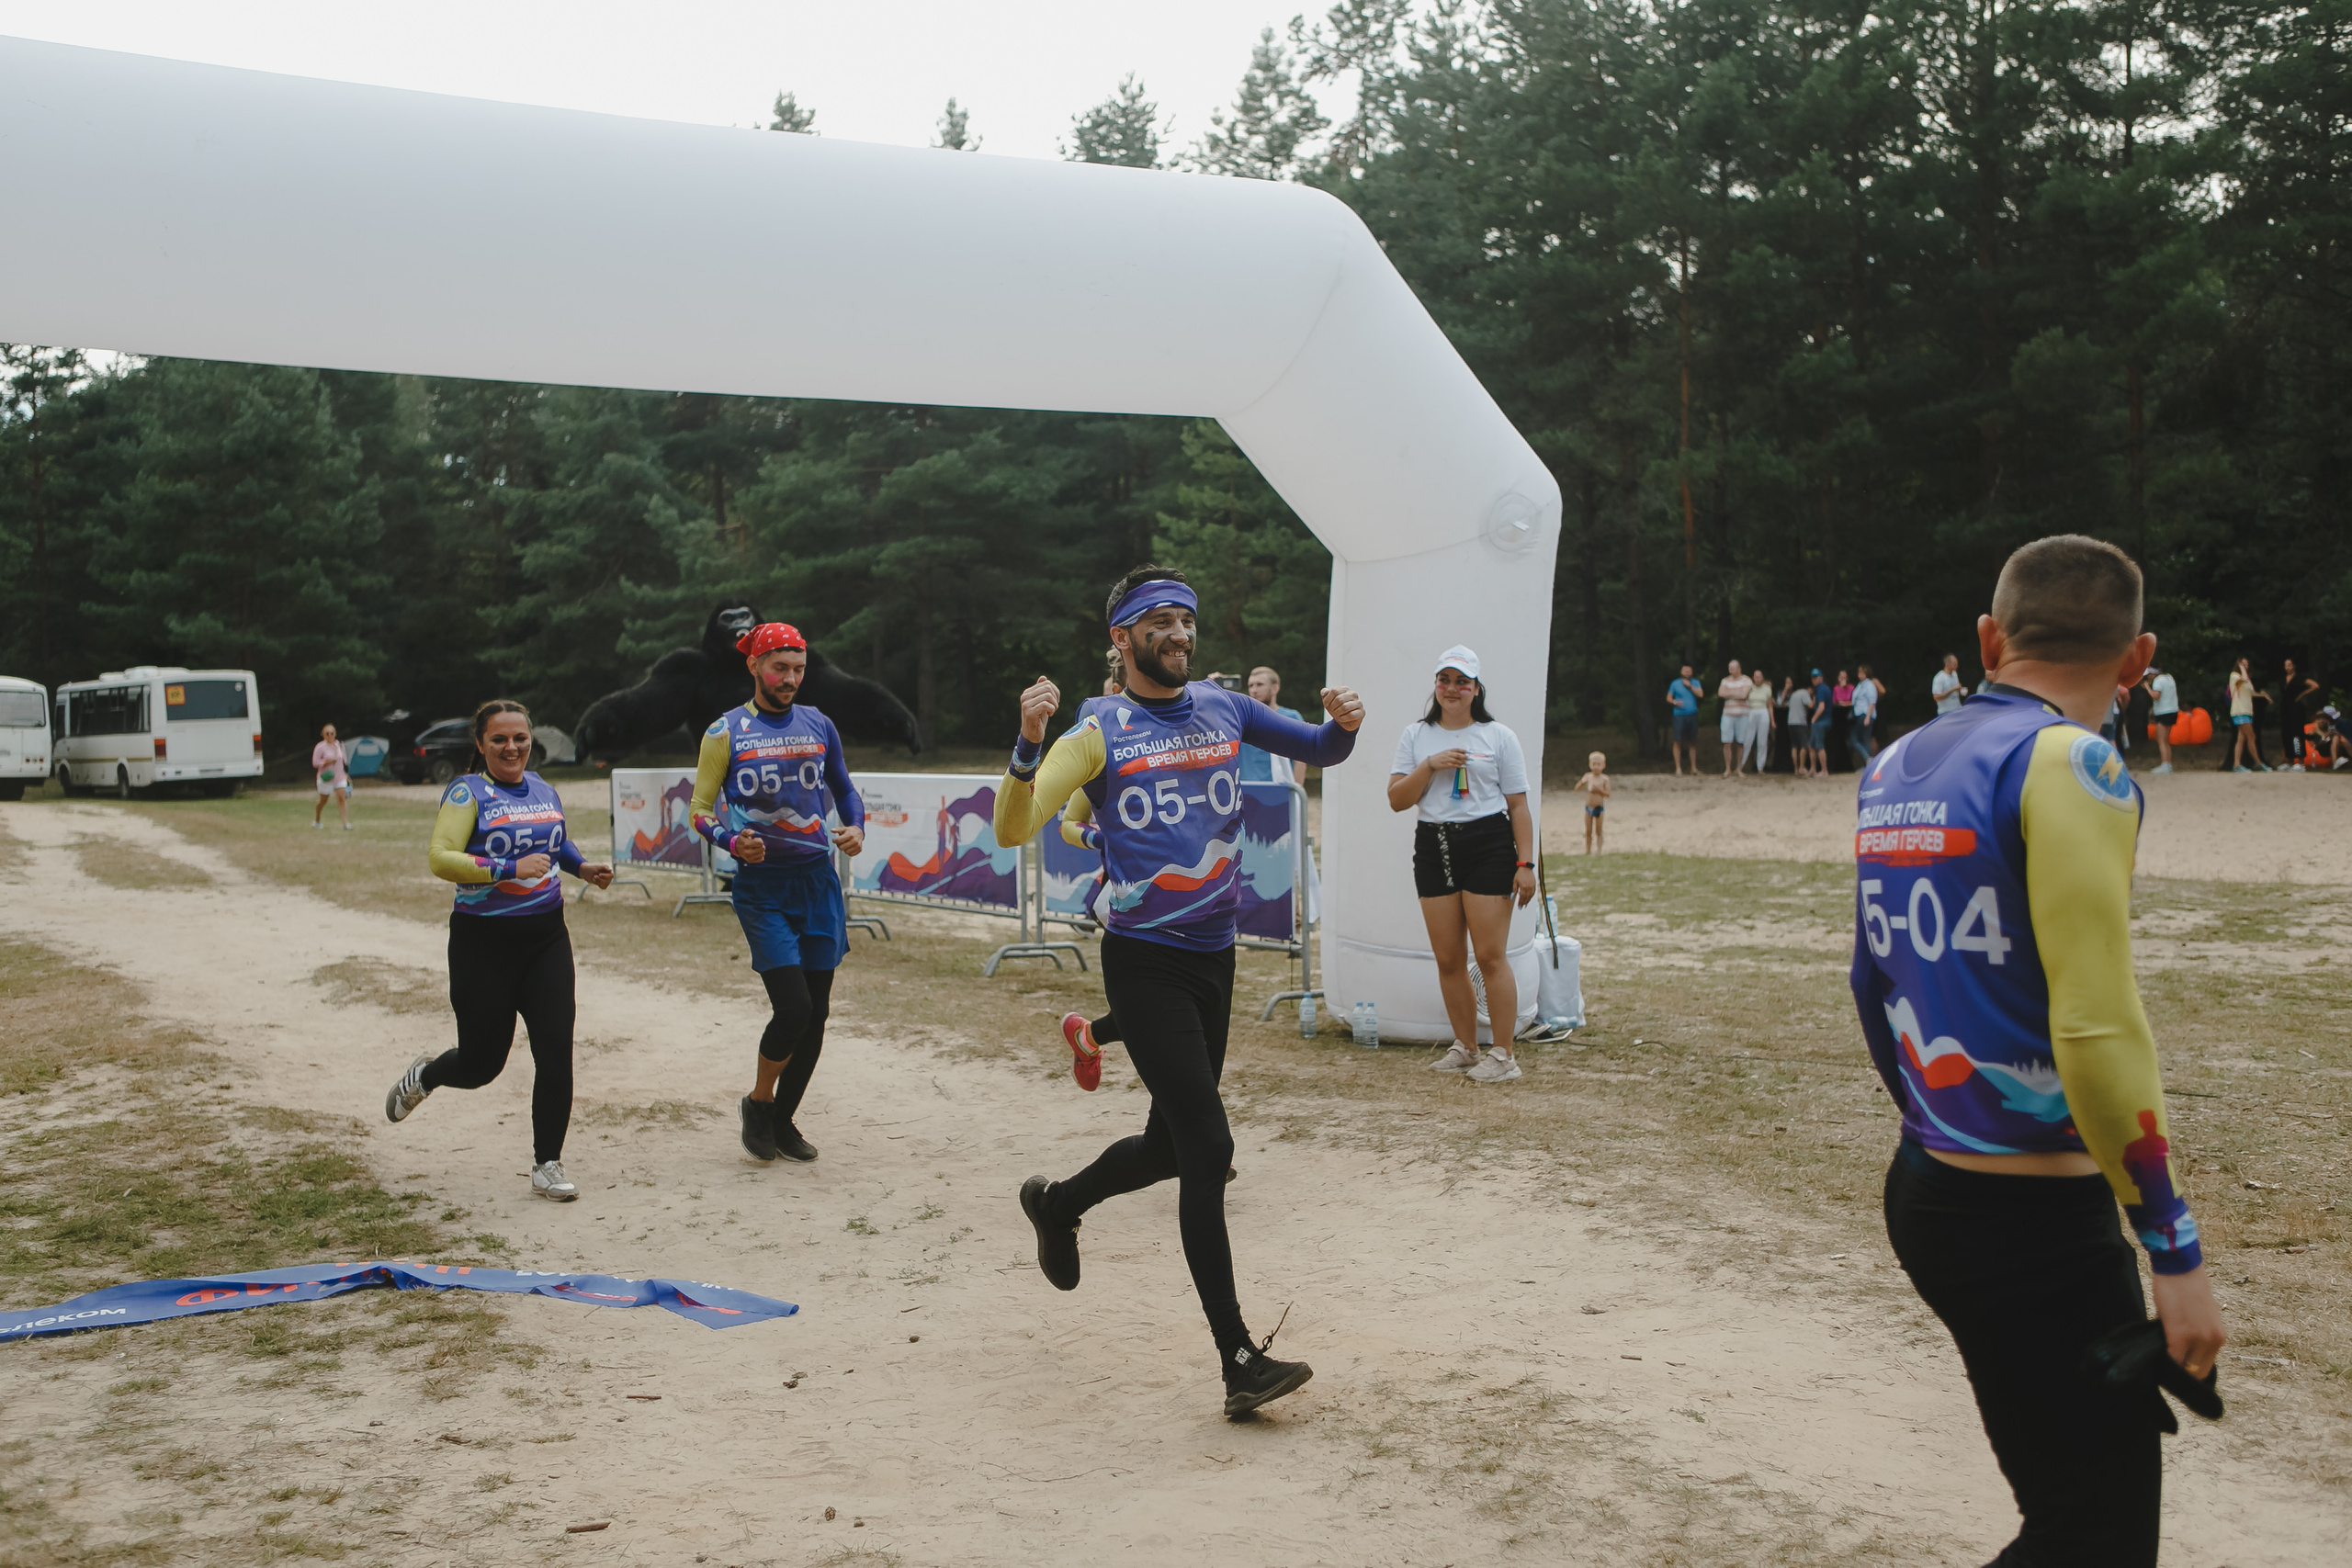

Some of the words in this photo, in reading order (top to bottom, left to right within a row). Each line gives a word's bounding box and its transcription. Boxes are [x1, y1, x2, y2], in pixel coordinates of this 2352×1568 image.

[736, 737, 784, 751] БОЛЬШАЯ
[785, 736, 816, 746] ГОНКА
[1113, 730, 1152, 743] Ростелеком
[1113, 736, 1183, 761] БОЛЬШАЯ
[1184, 729, 1228, 748] ГОНКА
[757, 747, 786, 758] ВРЕМЯ
[787, 744, 818, 753] ГЕРОЕВ
[1147, 750, 1190, 768] ВРЕМЯ
[1190, 744, 1232, 761] ГЕРОЕВ
[483, 805, 530, 821] БОЛЬШАЯ
[1903, 800, 1948, 825] ГОНКА
[1859, 830, 1899, 854] ВРЕМЯ
[1900, 829, 1945, 852] ГЕРОЕВ
